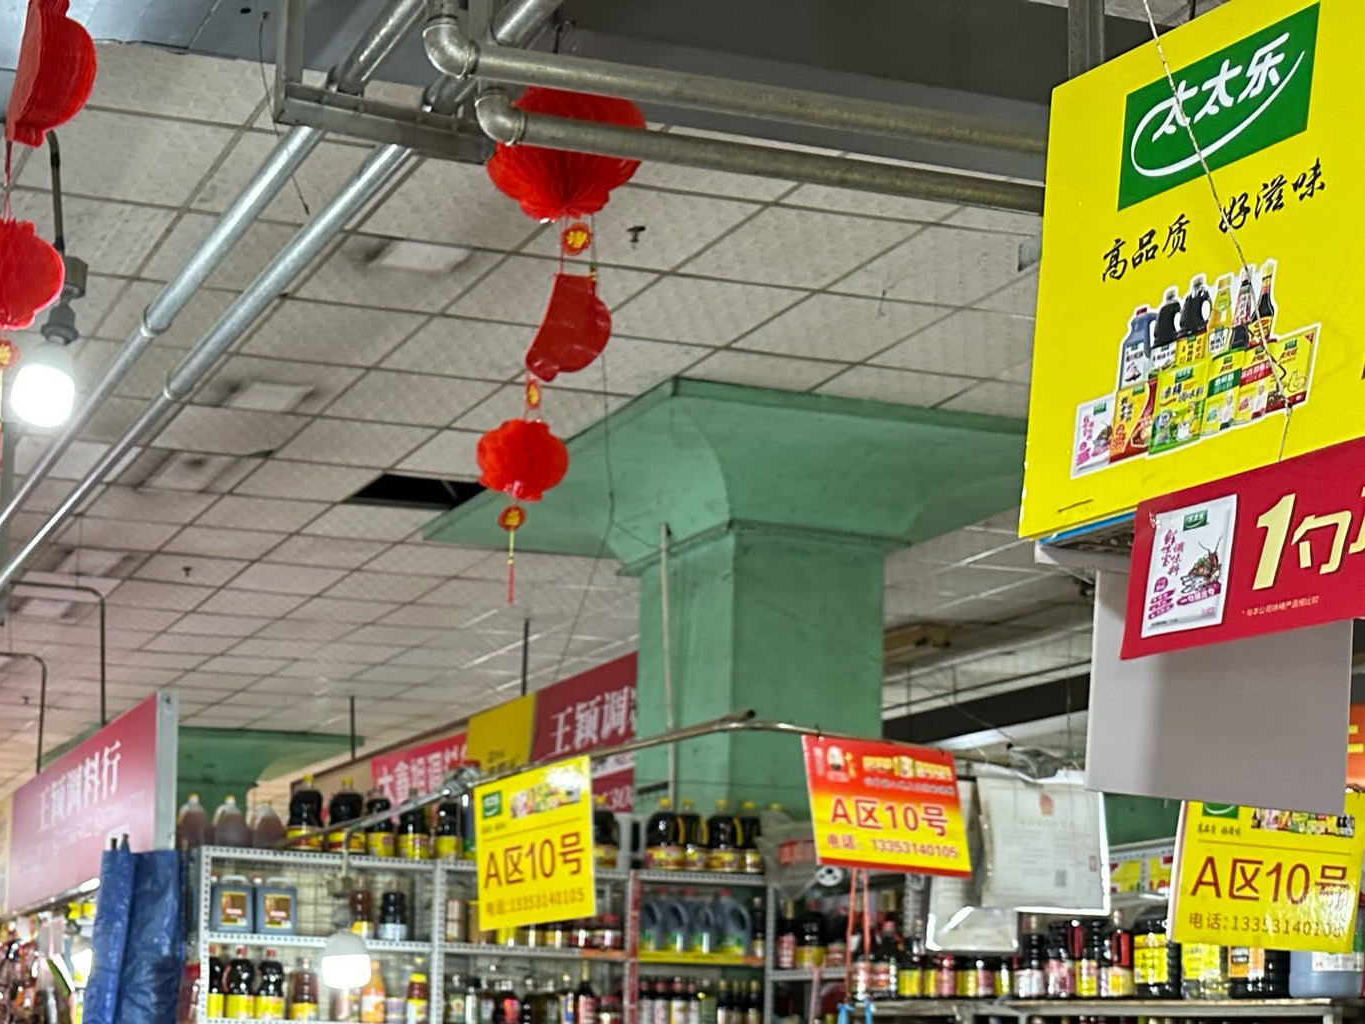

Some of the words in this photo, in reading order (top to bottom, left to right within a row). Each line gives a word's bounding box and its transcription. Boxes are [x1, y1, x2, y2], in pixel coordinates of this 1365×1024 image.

[1152, 32, 1290, 142] 太太乐
[1101, 213, 1191, 283] 高品质
[1218, 157, 1327, 235] 好滋味
[1252, 486, 1365, 591] 1勺
[550, 686, 636, 754] 王颖调
[831, 798, 948, 836] A区10号
[484, 831, 585, 889] A区10号
[1190, 855, 1351, 906] A区10号
